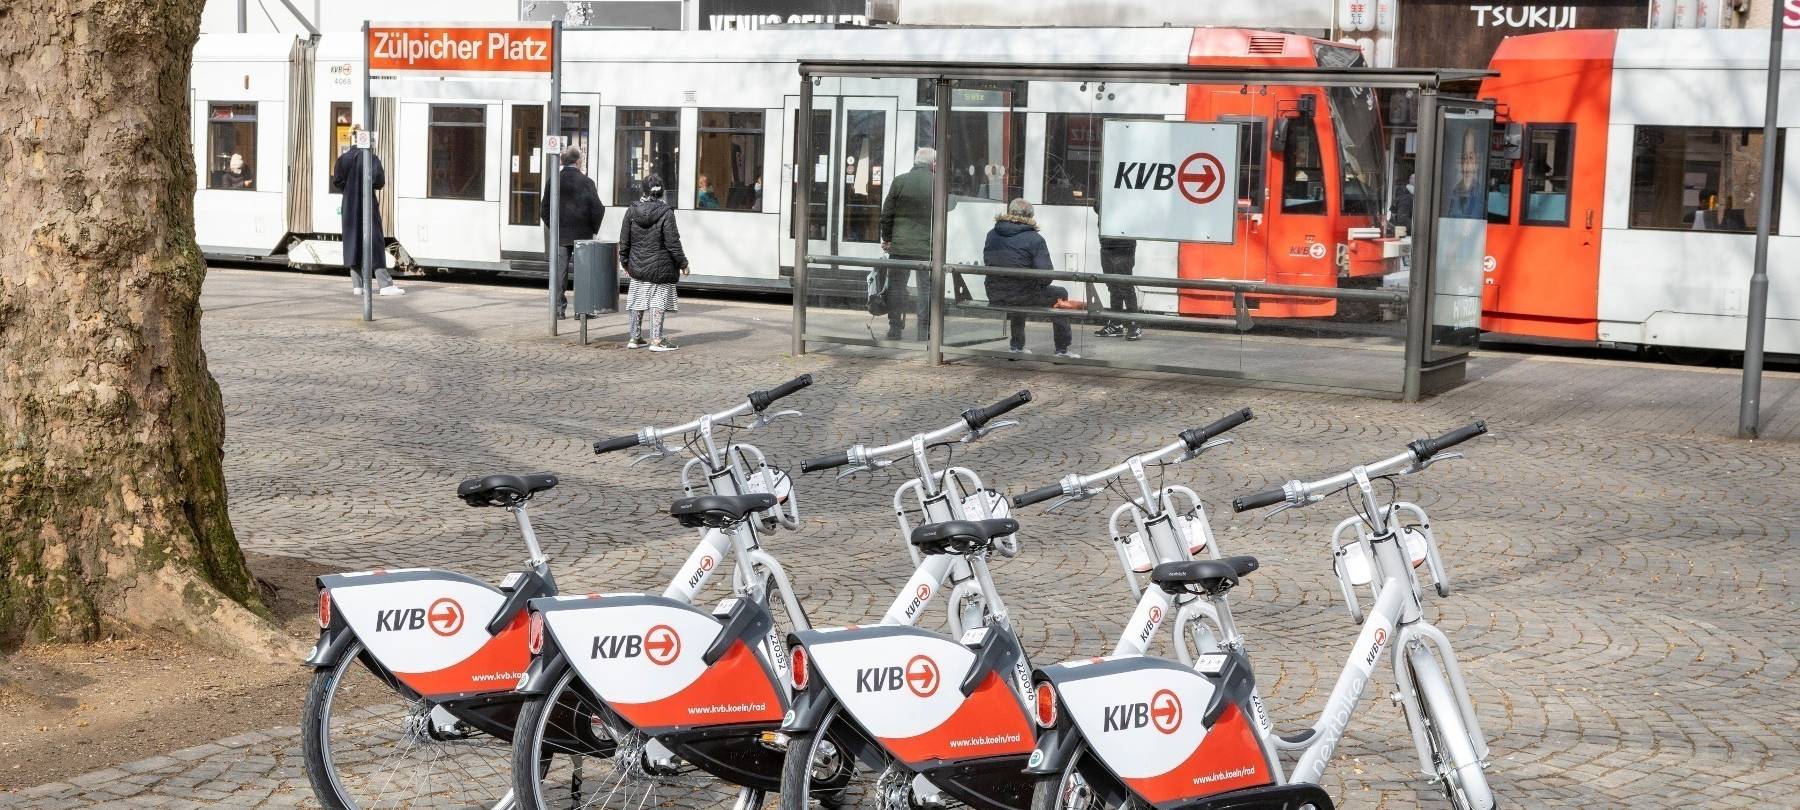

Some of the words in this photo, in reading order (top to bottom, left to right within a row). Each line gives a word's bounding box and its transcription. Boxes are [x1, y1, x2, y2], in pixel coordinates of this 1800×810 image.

[1470, 5, 1577, 29] TSUKIJI
[374, 31, 482, 65] Zülpicher
[488, 32, 548, 61] Platz
[1113, 161, 1176, 191] KVB
[689, 567, 704, 589] KVB
[905, 596, 921, 619] KVB
[375, 608, 425, 633] KVB
[1140, 619, 1154, 643] KVB
[590, 634, 642, 660] KVB
[770, 634, 786, 670] 220352
[1366, 642, 1379, 666] KVB
[856, 666, 904, 693] KVB
[1016, 661, 1035, 701] 220096
[687, 702, 766, 715] www.kvb.koeln/rad
[1103, 702, 1149, 733] KVB
[1312, 677, 1364, 777] nextbike
[949, 732, 1021, 748] www.kvb.koeln/rad
[1192, 765, 1255, 785] www.kvb.koeln/rad
